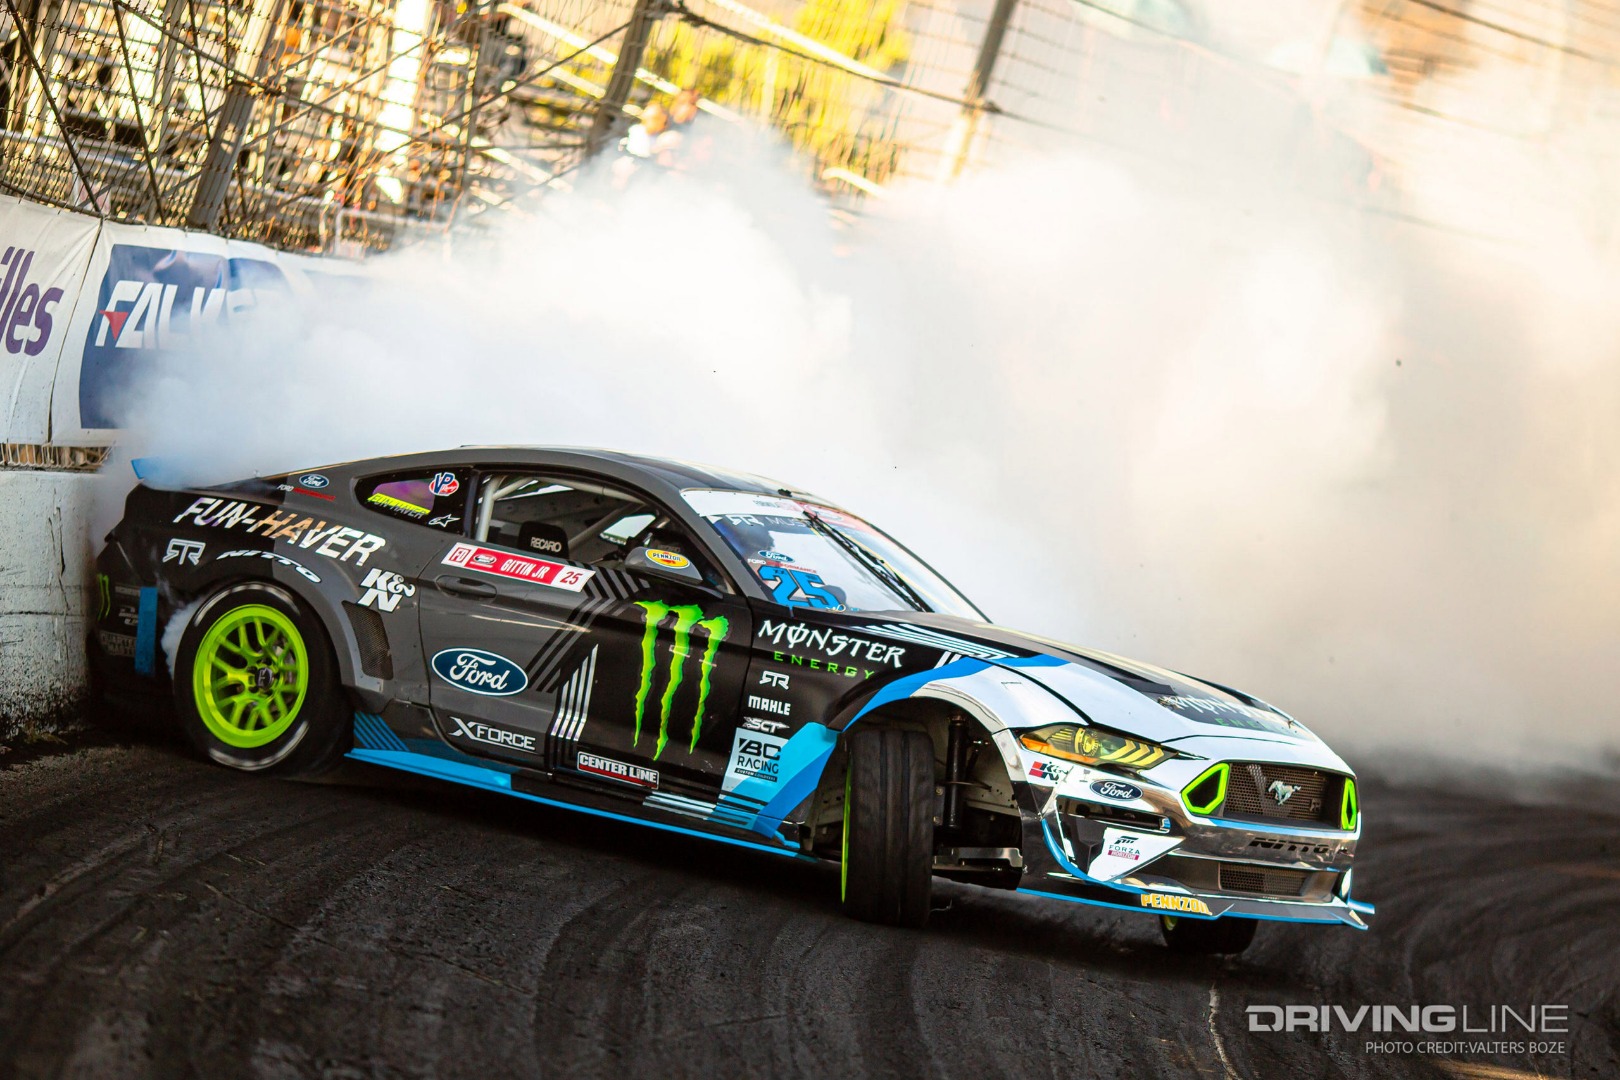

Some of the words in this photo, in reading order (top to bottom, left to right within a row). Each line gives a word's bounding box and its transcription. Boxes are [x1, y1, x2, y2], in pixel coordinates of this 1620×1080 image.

[276, 484, 294, 492] FORD
[302, 474, 325, 487] Ford
[433, 472, 455, 494] VP
[173, 497, 386, 566] FUN-HAVER
[765, 516, 807, 528] MUS
[162, 538, 206, 566] RTR
[530, 536, 562, 552] RECARO
[216, 549, 322, 583] NITTO
[500, 559, 535, 576] GITTIN
[532, 565, 550, 579] JR
[560, 571, 583, 585] 25
[357, 568, 416, 613] K&N
[757, 565, 841, 608] 25
[449, 653, 511, 690] Ford
[773, 651, 875, 679] ENERGY
[759, 670, 790, 690] RTR
[748, 695, 791, 715] MAHLE
[449, 717, 536, 751] XFORCE
[748, 717, 782, 733] SCT
[738, 738, 781, 761] BC
[579, 754, 628, 775] CENTER
[629, 767, 658, 784] LINE
[737, 756, 779, 774] RACING
[1100, 781, 1134, 799] Ford
[1108, 845, 1140, 855] FORZA
[1248, 837, 1330, 854] NITTO
[1140, 893, 1213, 916] PENNZOIL
